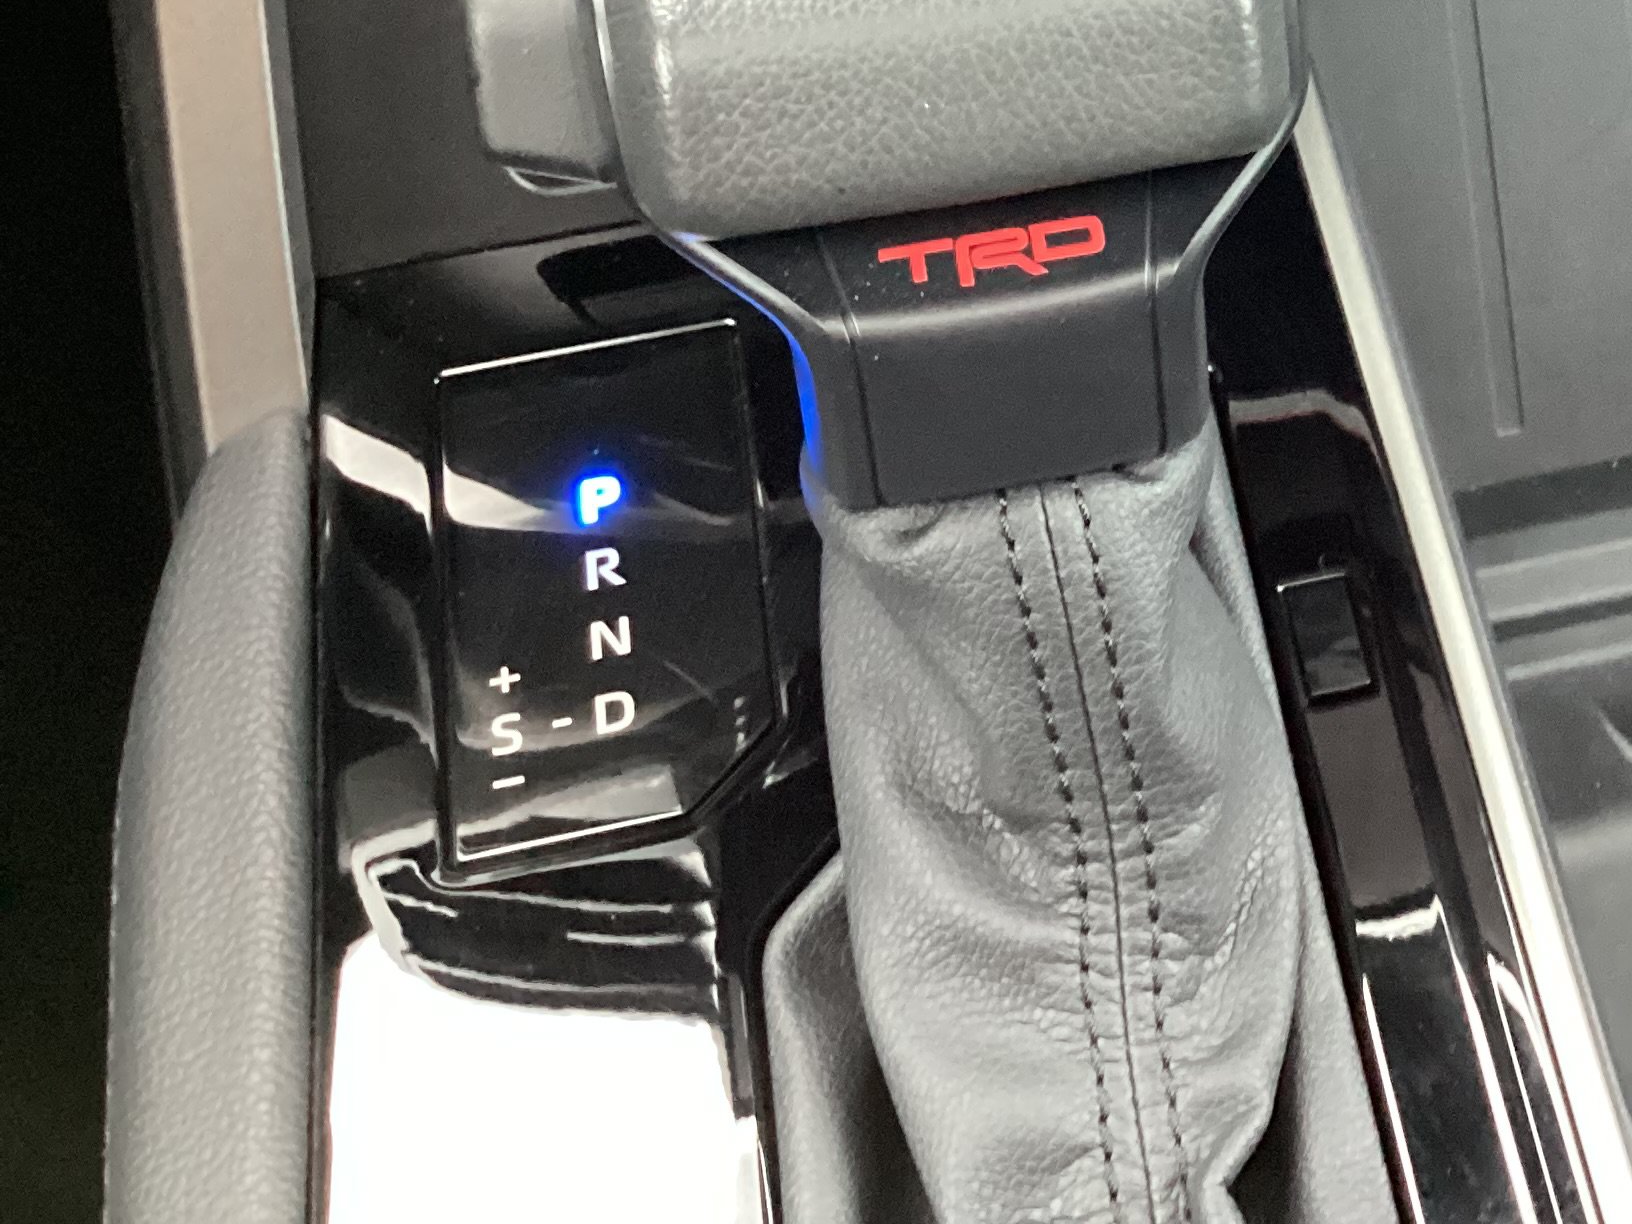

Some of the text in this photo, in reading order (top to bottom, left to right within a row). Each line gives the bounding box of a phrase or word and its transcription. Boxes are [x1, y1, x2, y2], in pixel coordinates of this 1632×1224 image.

[877, 214, 1106, 288] TRD
[577, 474, 622, 526] P
[584, 546, 627, 591] R
[589, 615, 632, 661] N
[491, 712, 523, 756] S
[594, 690, 636, 735] D
